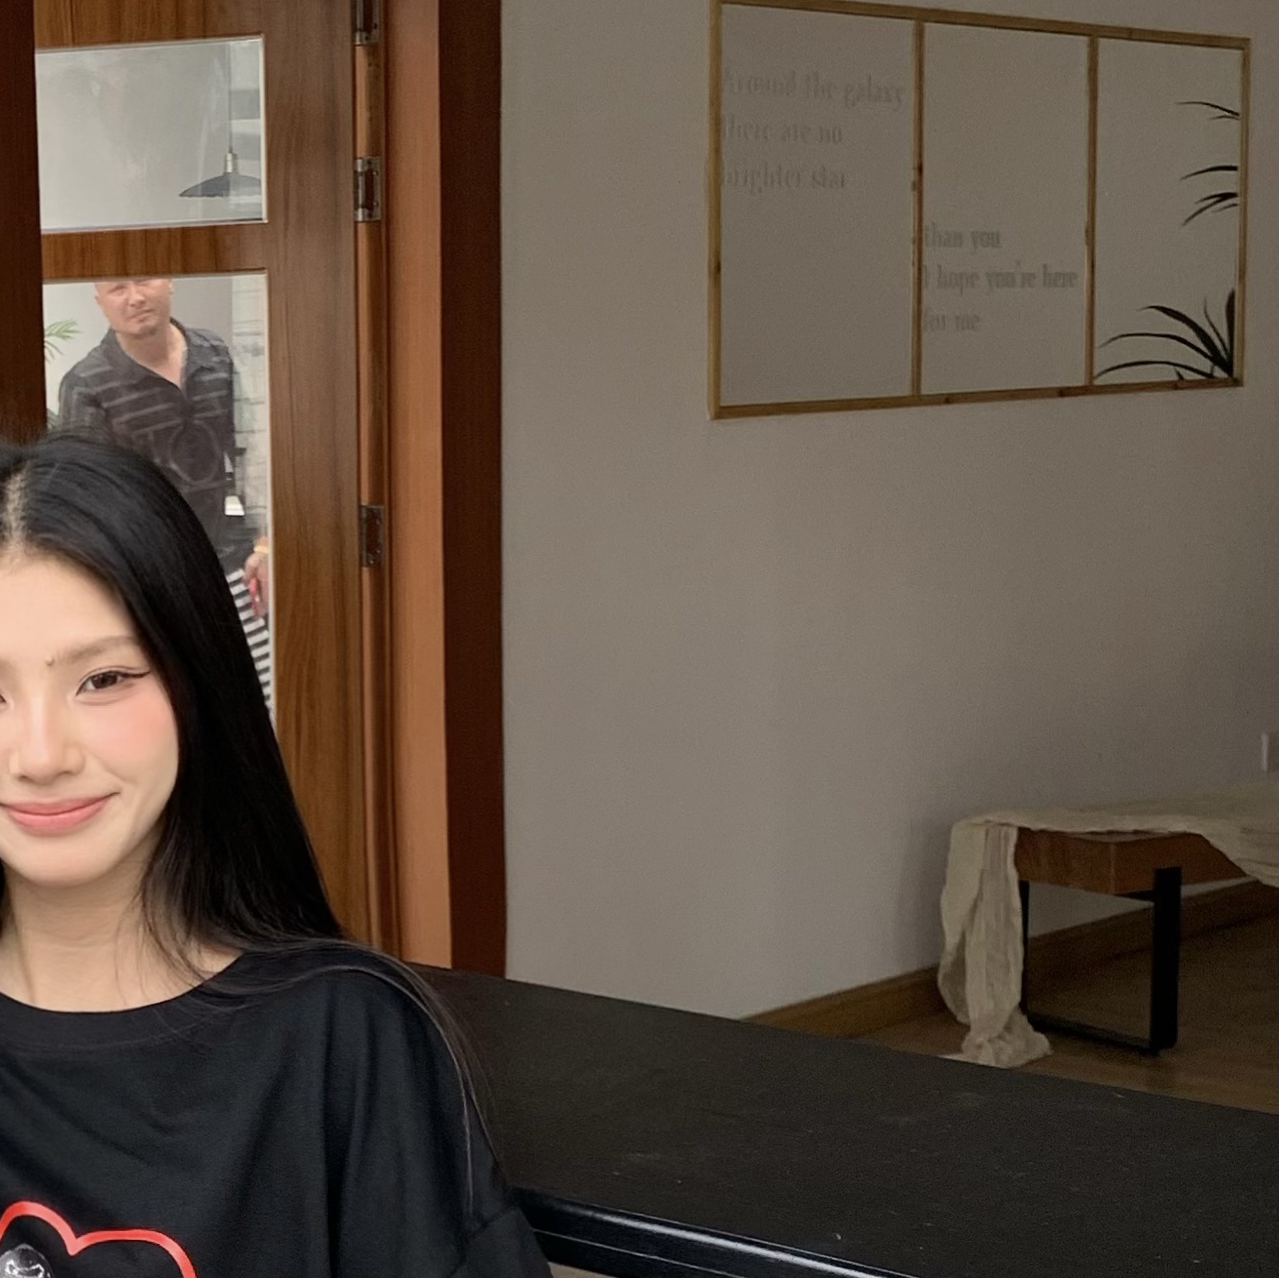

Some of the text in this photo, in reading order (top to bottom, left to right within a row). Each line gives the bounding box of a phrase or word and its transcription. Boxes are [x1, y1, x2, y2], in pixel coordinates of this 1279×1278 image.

[804, 71, 839, 101] the
[843, 74, 907, 112] galaxy
[780, 123, 813, 144] are
[818, 125, 844, 145] no
[970, 230, 1002, 255] you
[936, 262, 981, 297] hope
[1041, 262, 1080, 289] here
[953, 313, 982, 332] me
